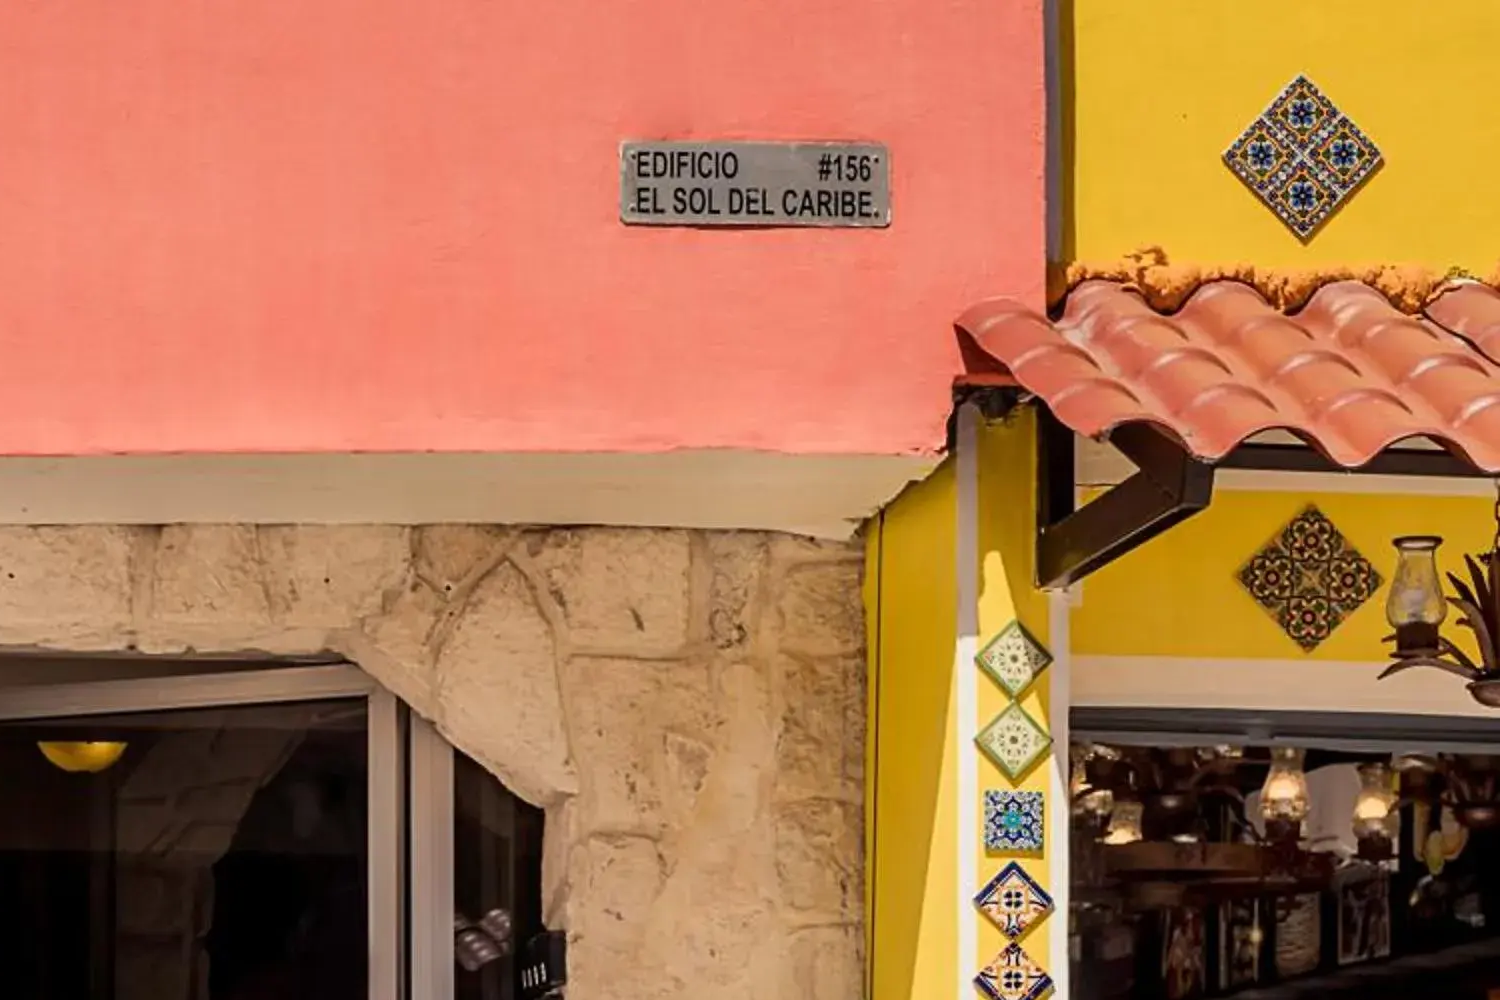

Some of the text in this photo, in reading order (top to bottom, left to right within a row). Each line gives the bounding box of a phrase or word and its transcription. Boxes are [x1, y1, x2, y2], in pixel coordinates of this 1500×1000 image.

[636, 151, 872, 182] EDIFICIO #156
[636, 187, 872, 218] EL SOL DEL CARIBE
